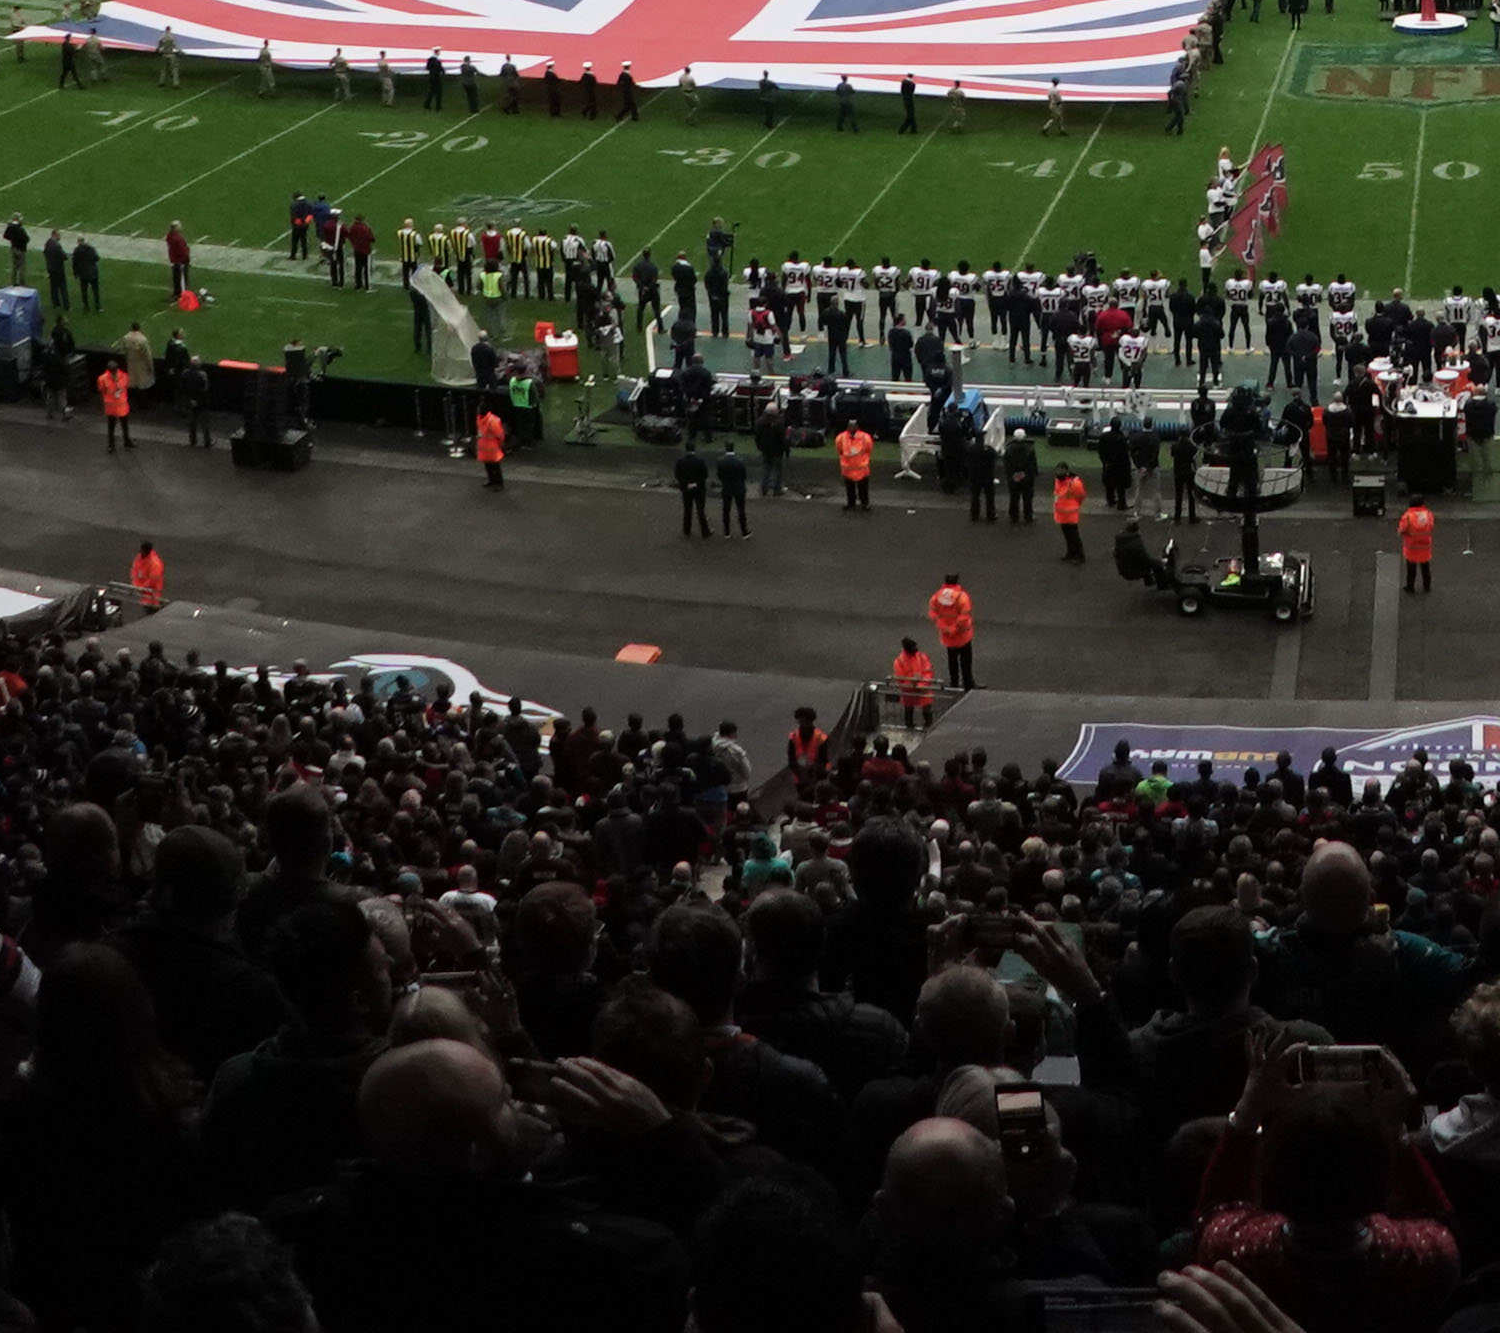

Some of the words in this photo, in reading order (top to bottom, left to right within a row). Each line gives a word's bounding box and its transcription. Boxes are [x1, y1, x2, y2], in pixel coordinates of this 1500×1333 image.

[788, 271, 806, 284] 94
[917, 276, 931, 288] 91
[1120, 288, 1136, 300] 24
[1149, 289, 1163, 301] 51
[1230, 289, 1246, 301] 20
[1073, 347, 1089, 359] 22
[1123, 347, 1140, 360] 27
[1128, 748, 1280, 761] SUBWAY
